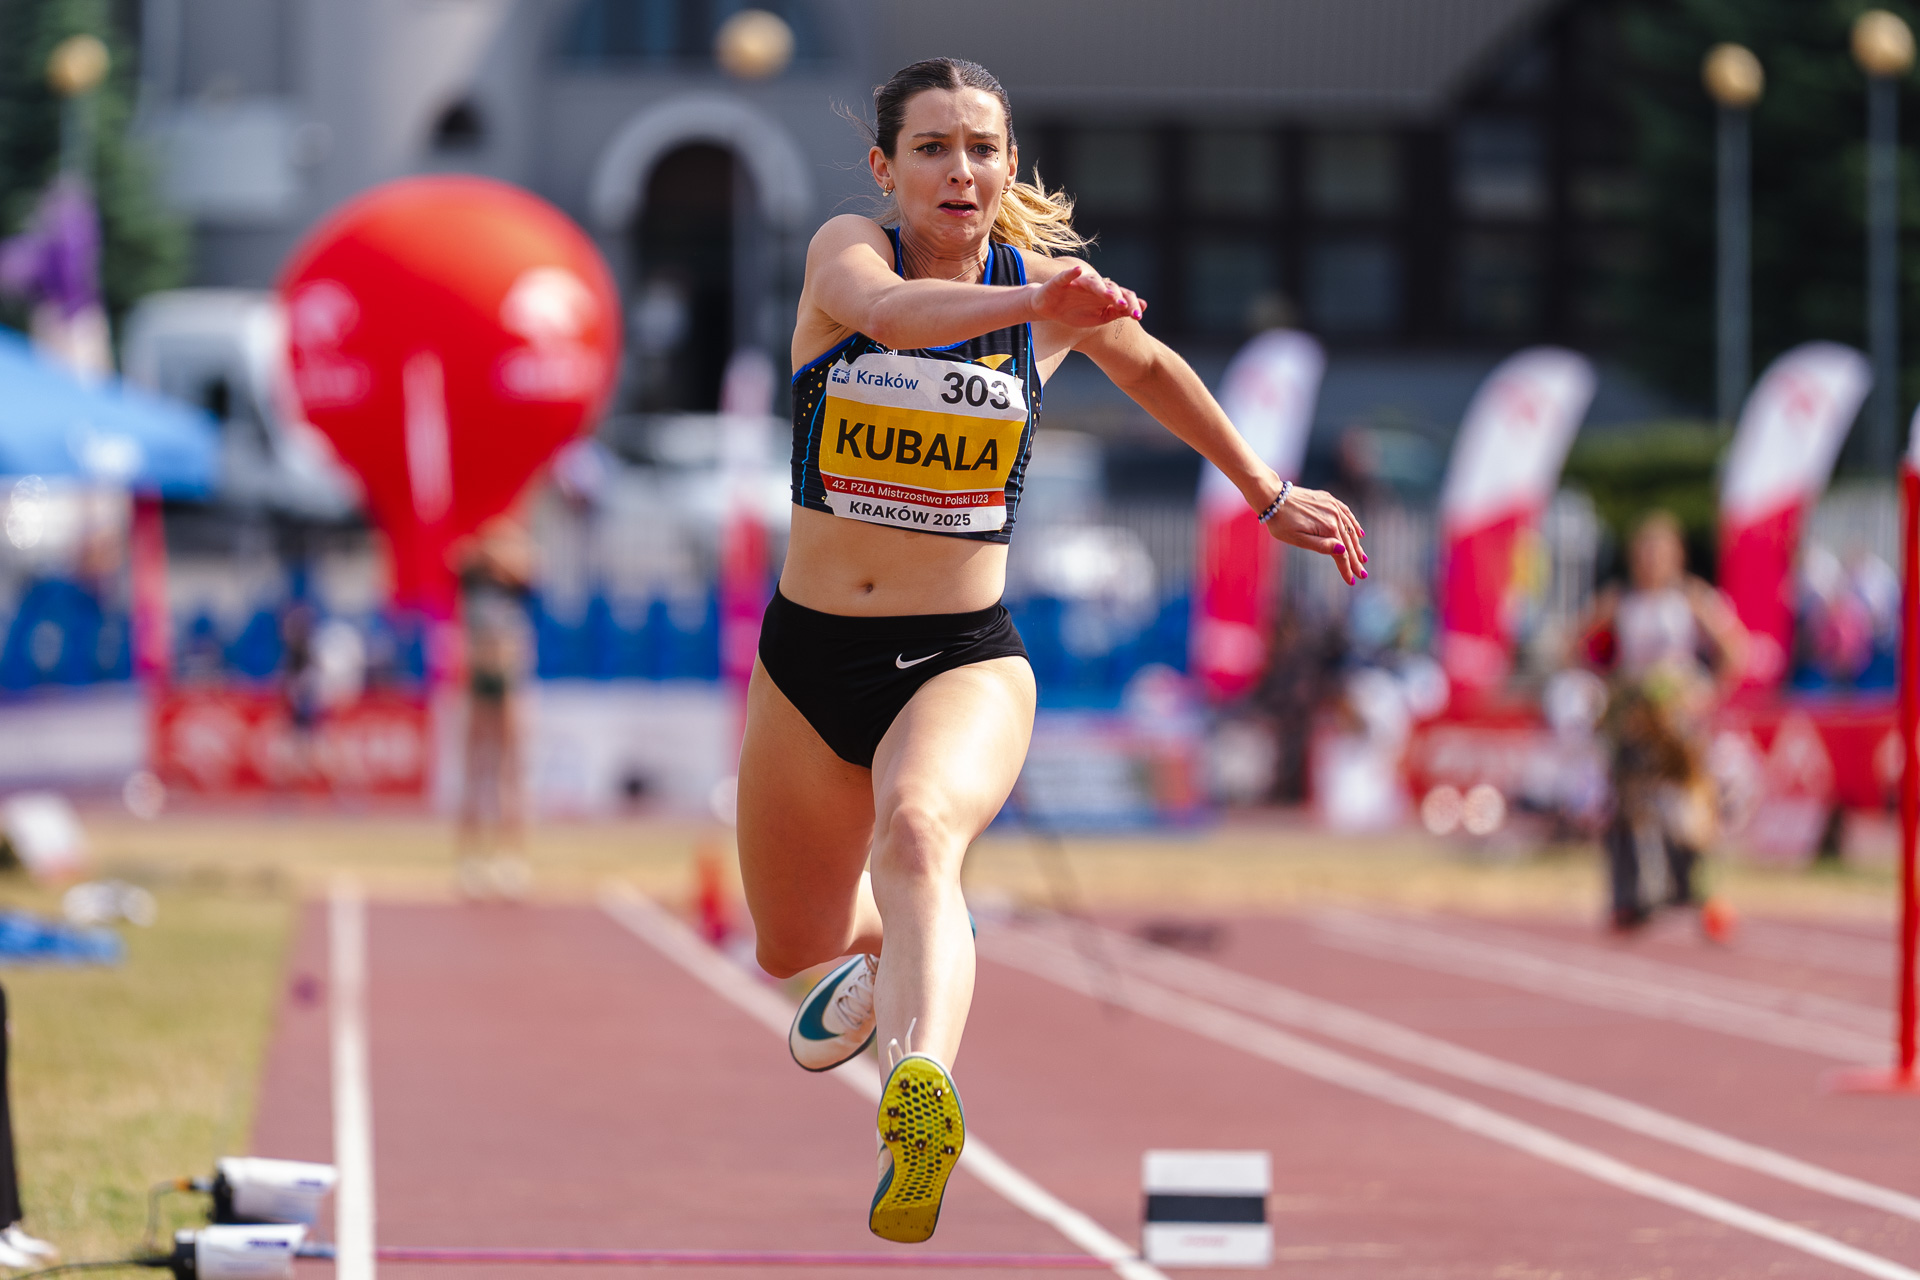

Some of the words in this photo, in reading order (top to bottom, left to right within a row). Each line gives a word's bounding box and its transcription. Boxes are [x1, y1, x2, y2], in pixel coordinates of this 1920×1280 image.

[856, 369, 919, 390] Kraków
[941, 371, 1011, 410] 303
[835, 418, 998, 471] KUBALA
[832, 479, 848, 491] 42.
[850, 482, 875, 495] PZLA
[877, 486, 942, 505] Mistrzostwa
[944, 494, 970, 506] Polski
[971, 494, 988, 504] U23
[849, 500, 930, 524] KRAKÓW
[932, 513, 971, 527] 2025
